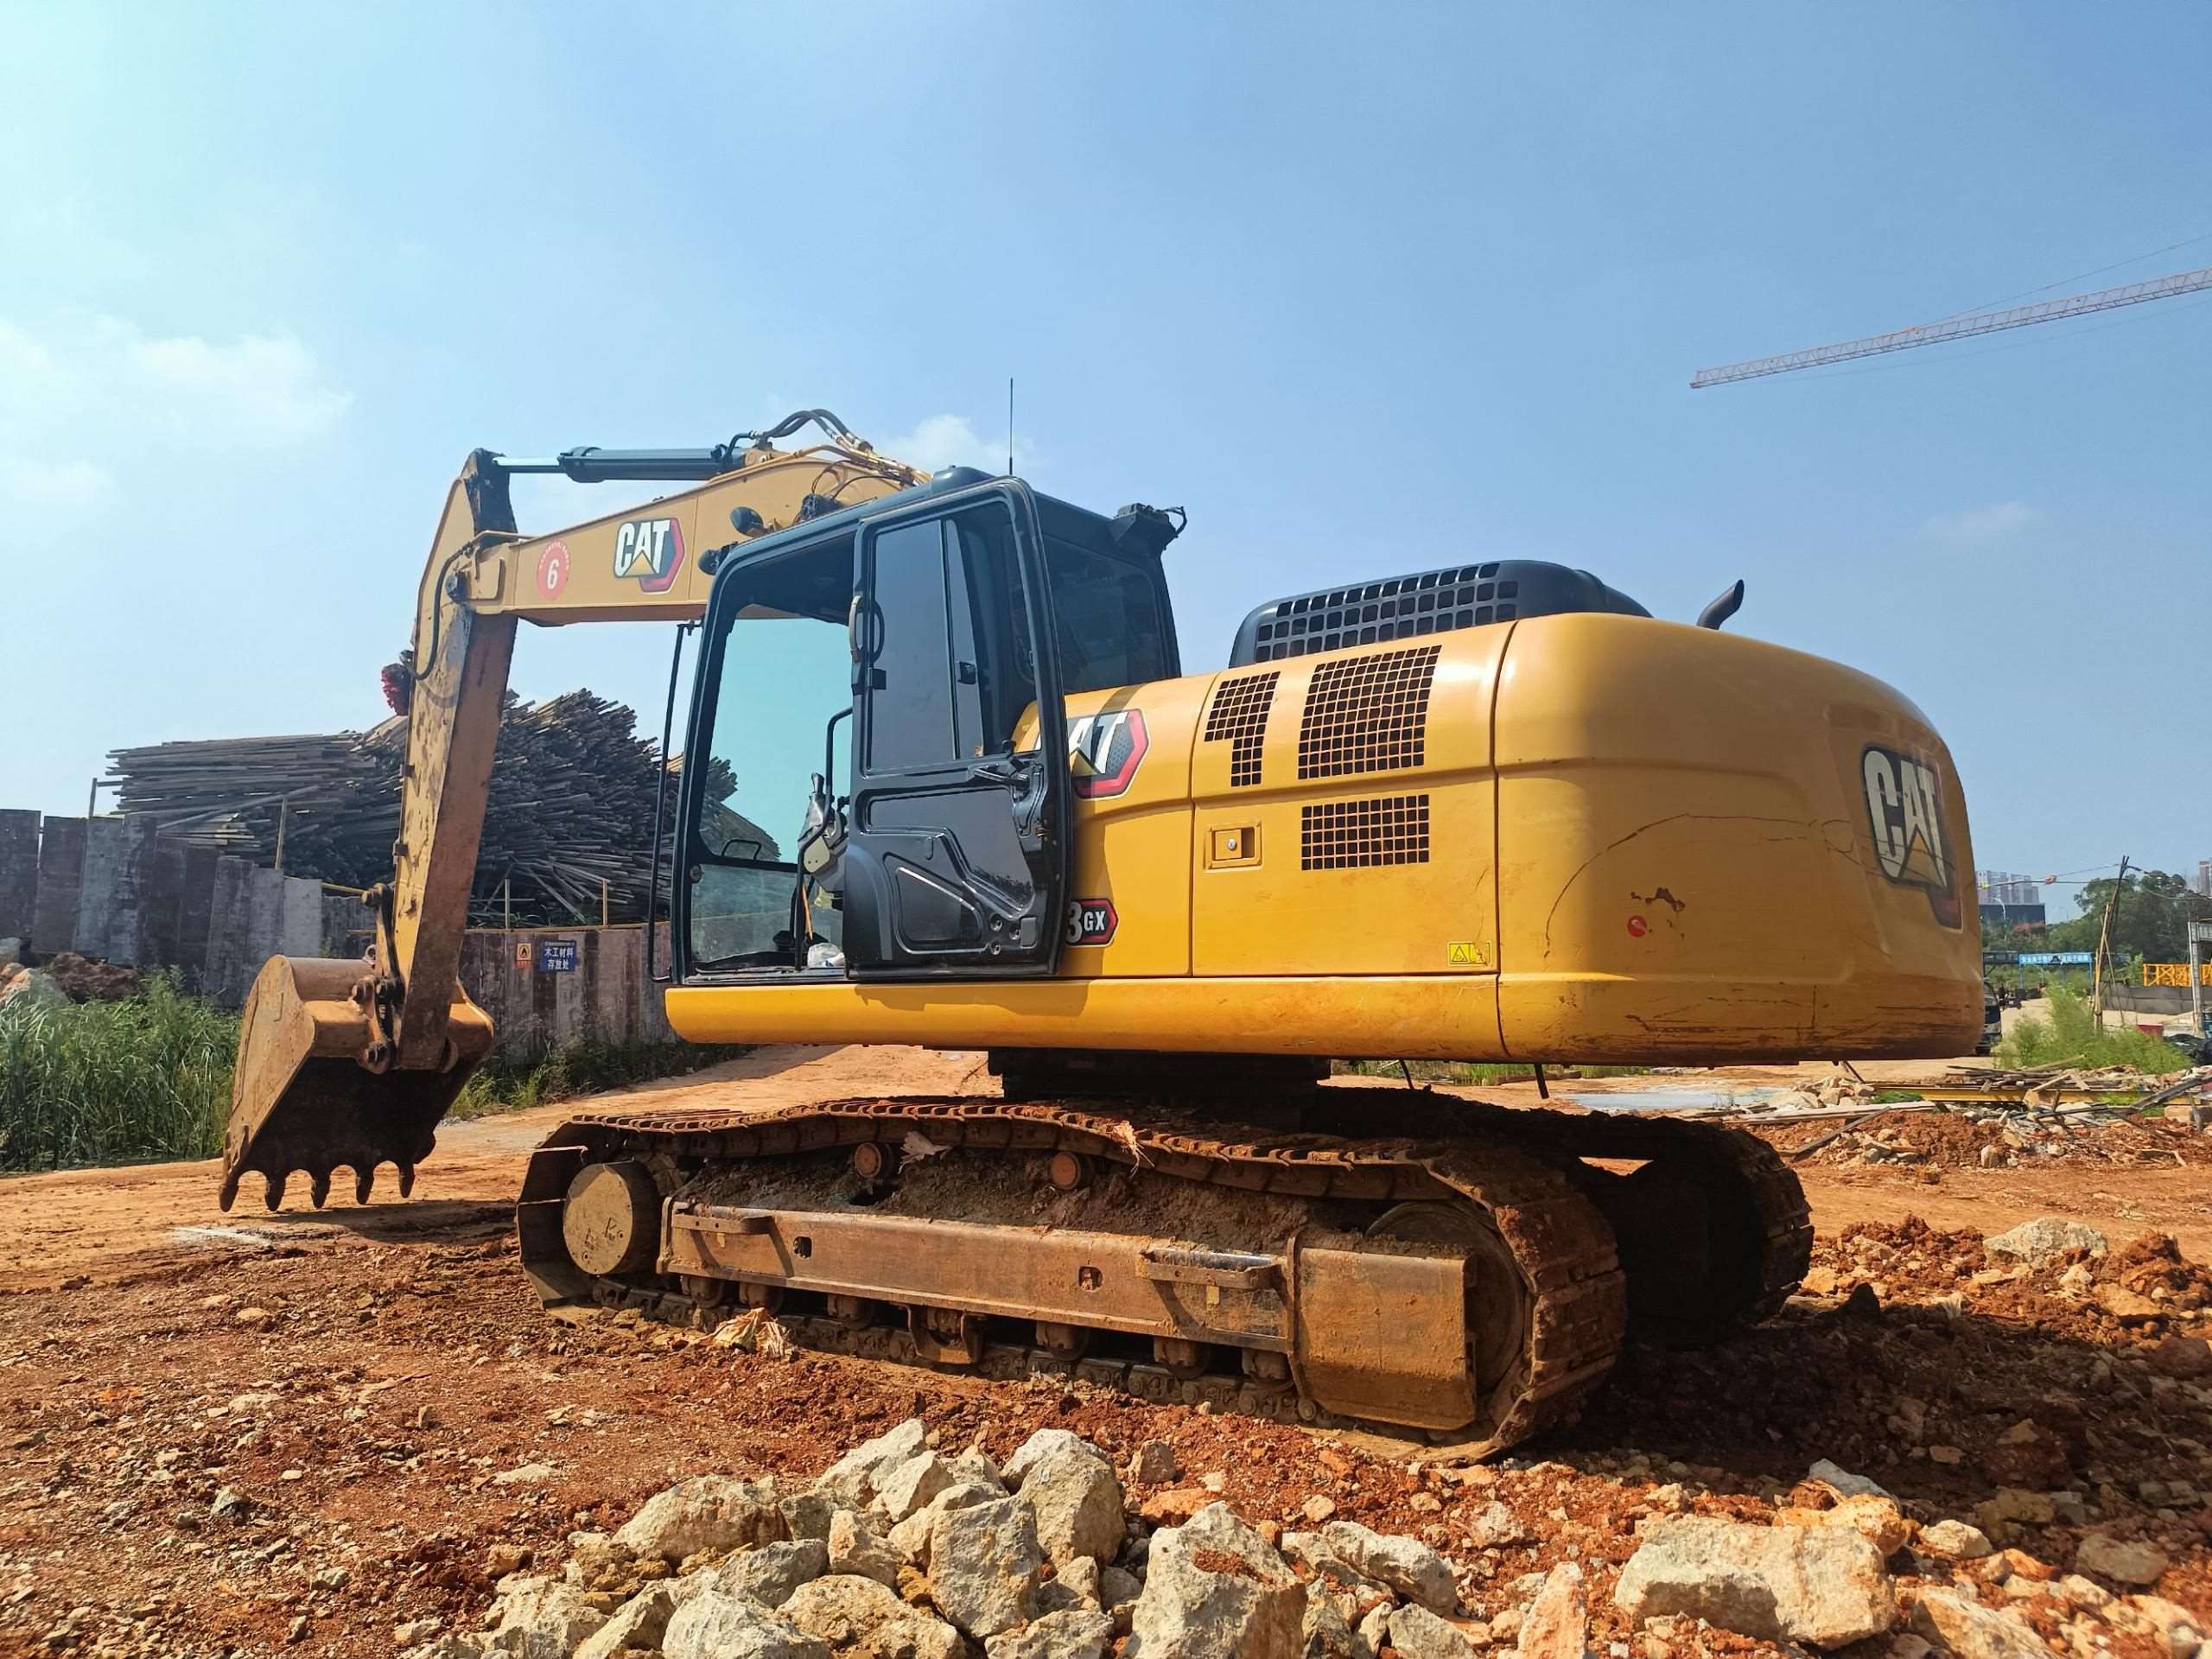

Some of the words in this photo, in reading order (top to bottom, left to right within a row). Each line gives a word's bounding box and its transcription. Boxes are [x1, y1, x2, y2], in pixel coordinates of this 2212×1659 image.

[614, 519, 671, 577] CAT
[547, 559, 559, 589] 6
[1864, 750, 1948, 888] CAT
[544, 947, 574, 958] 木工材料
